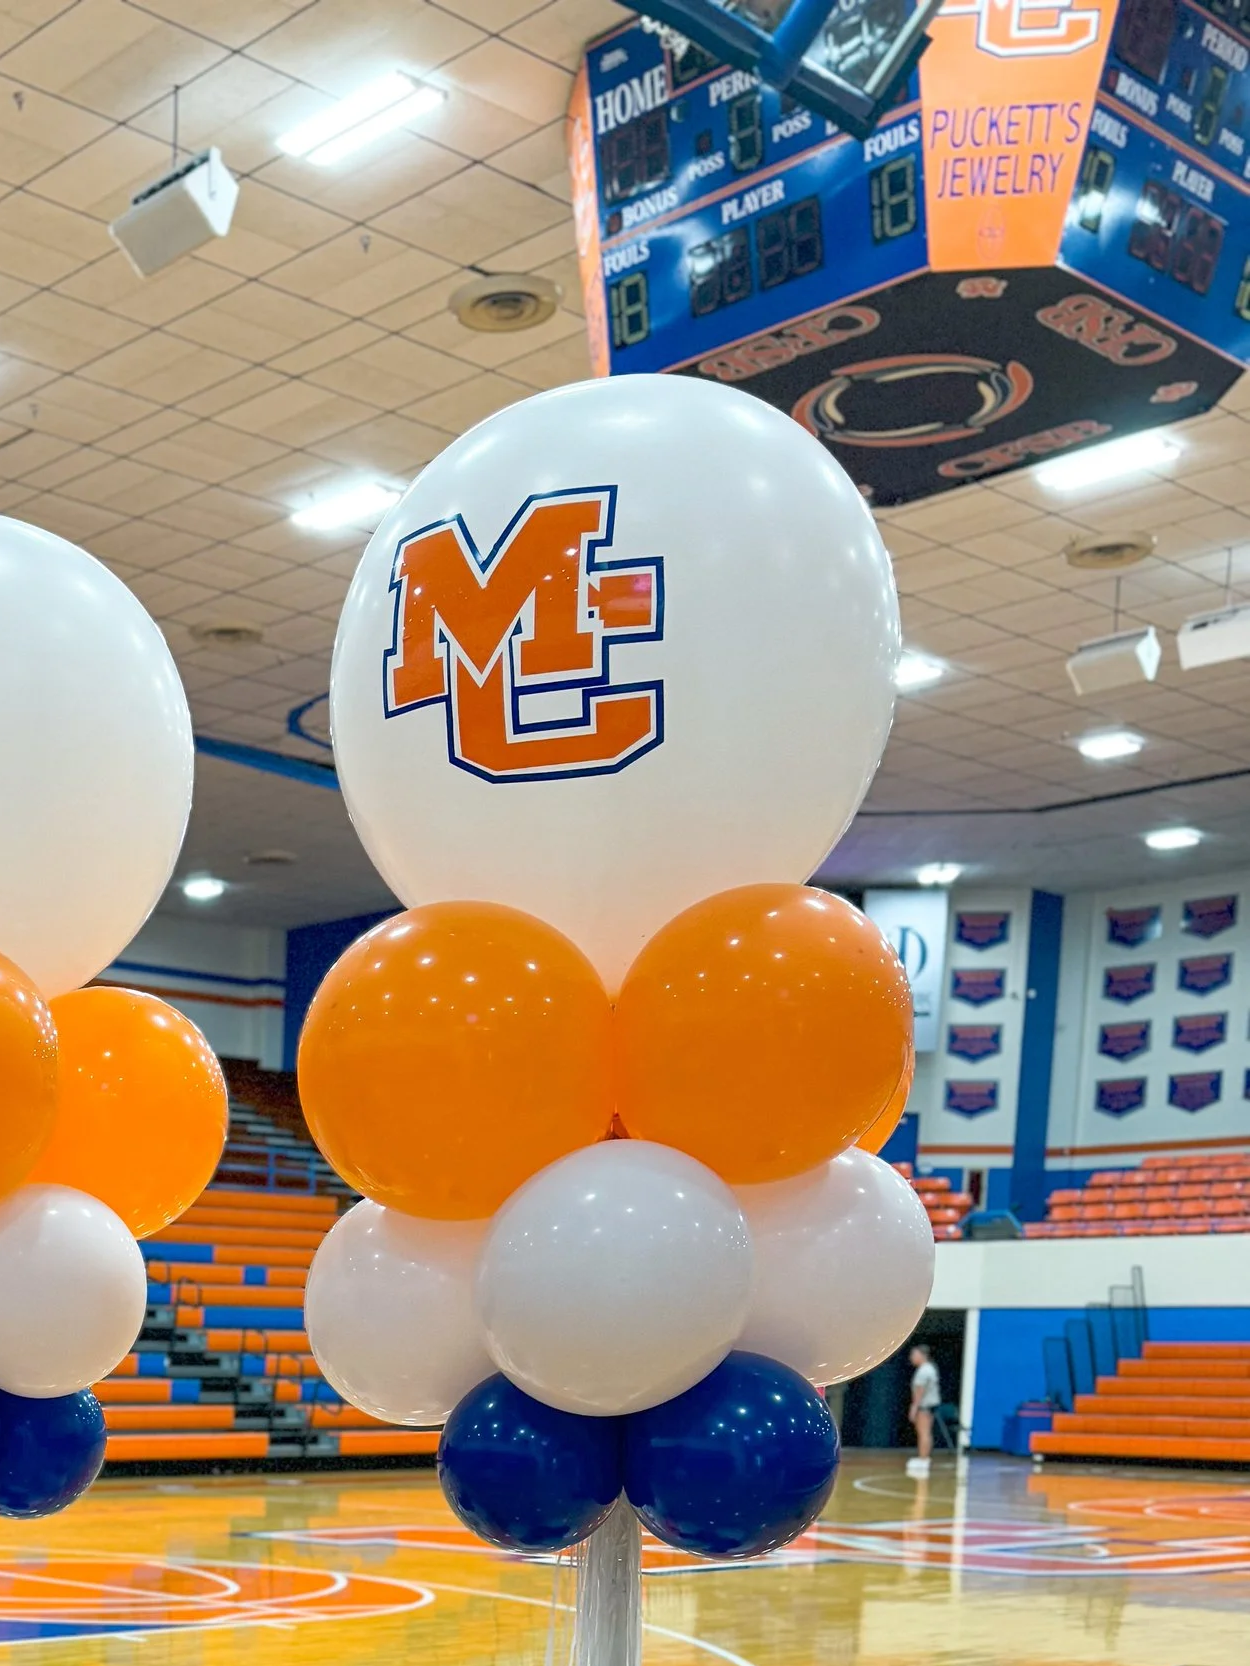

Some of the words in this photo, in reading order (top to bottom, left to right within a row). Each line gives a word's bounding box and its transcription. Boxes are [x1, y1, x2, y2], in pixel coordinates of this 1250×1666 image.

[595, 64, 669, 135] HOME
[709, 70, 761, 107] PERI
[772, 112, 812, 143] POSS
[863, 117, 921, 163] FOULS
[930, 102, 1082, 149] PUCKETT'S
[688, 151, 726, 182] POSS
[937, 153, 1064, 199] JEWELRY
[621, 187, 679, 229] BONUS
[721, 178, 785, 225] PLAYER
[603, 239, 651, 278] FOULS
[382, 485, 666, 784] MC
